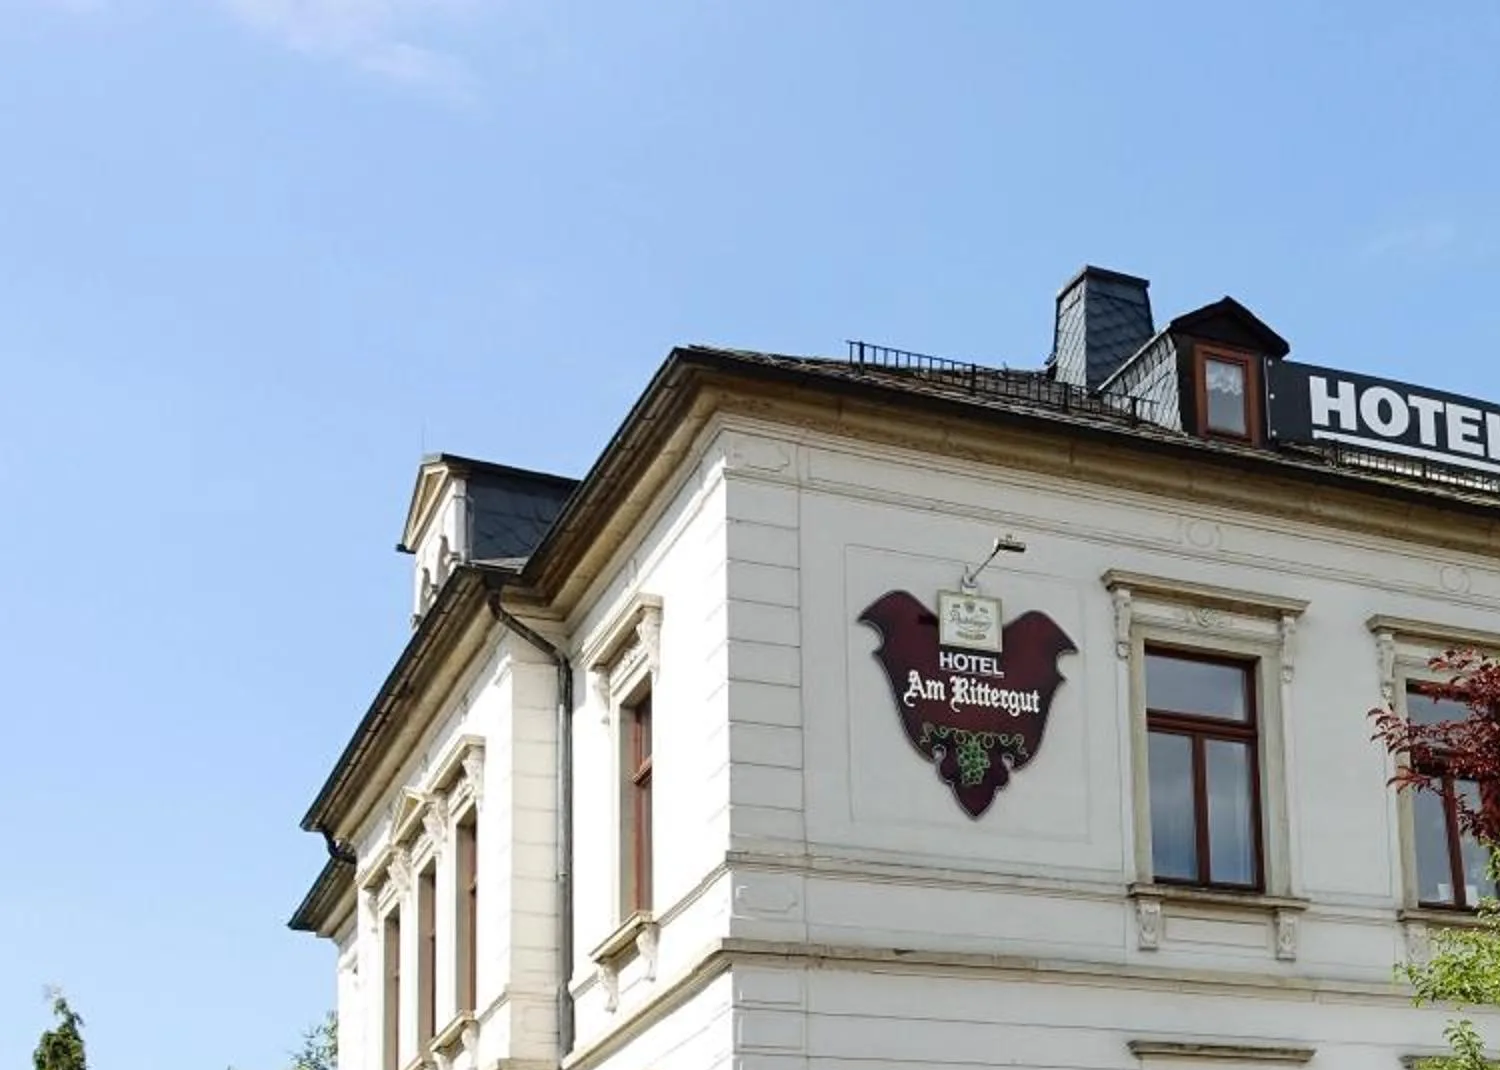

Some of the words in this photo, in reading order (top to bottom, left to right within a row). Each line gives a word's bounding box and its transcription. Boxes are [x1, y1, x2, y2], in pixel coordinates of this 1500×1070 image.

[939, 651, 1004, 675] HOTEL
[903, 669, 945, 707] Am
[950, 675, 1040, 717] Rittergut
